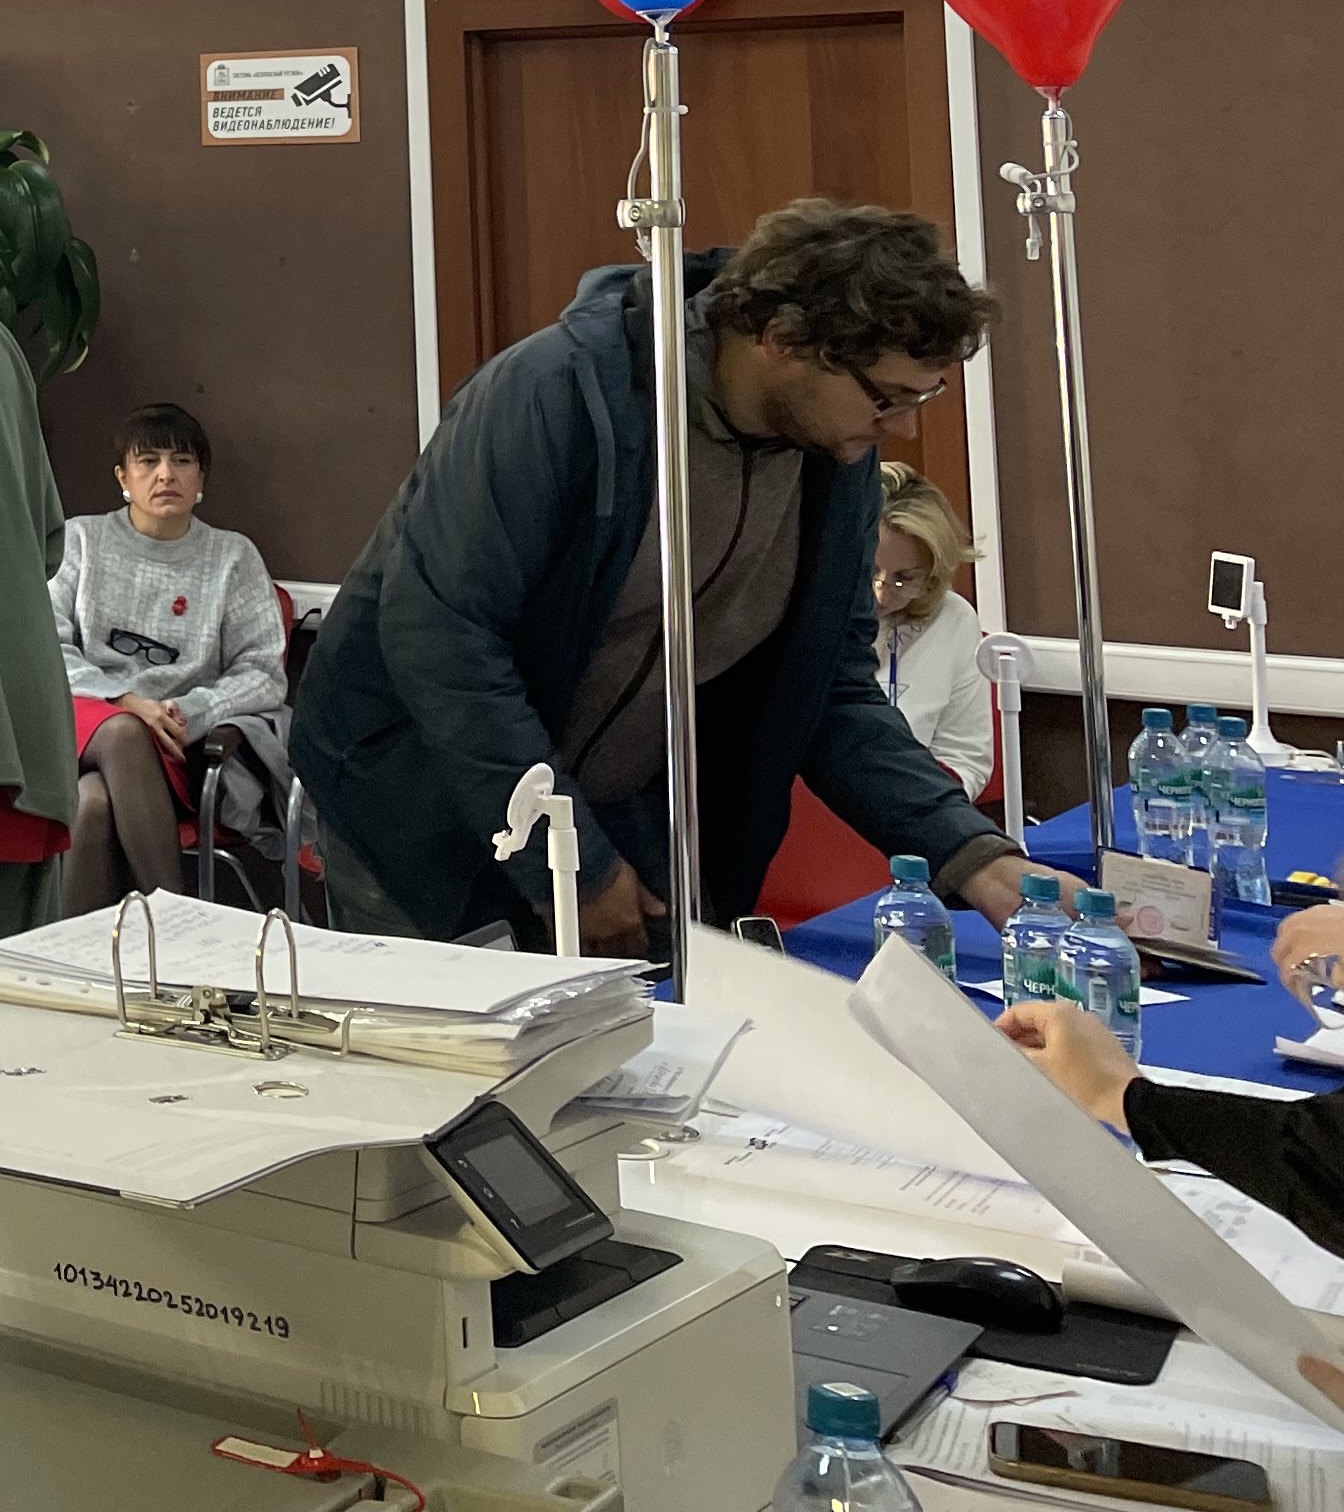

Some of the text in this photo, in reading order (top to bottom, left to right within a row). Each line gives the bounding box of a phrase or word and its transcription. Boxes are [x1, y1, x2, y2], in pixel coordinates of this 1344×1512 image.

[213, 90, 277, 102] ВНИМАНИЕ
[212, 106, 263, 119] ВЕДЕТСЯ
[213, 118, 336, 133] ВИДЕОНАБЛЮДЕНИЕ!
[53, 1262, 290, 1338] 10134220252019219
